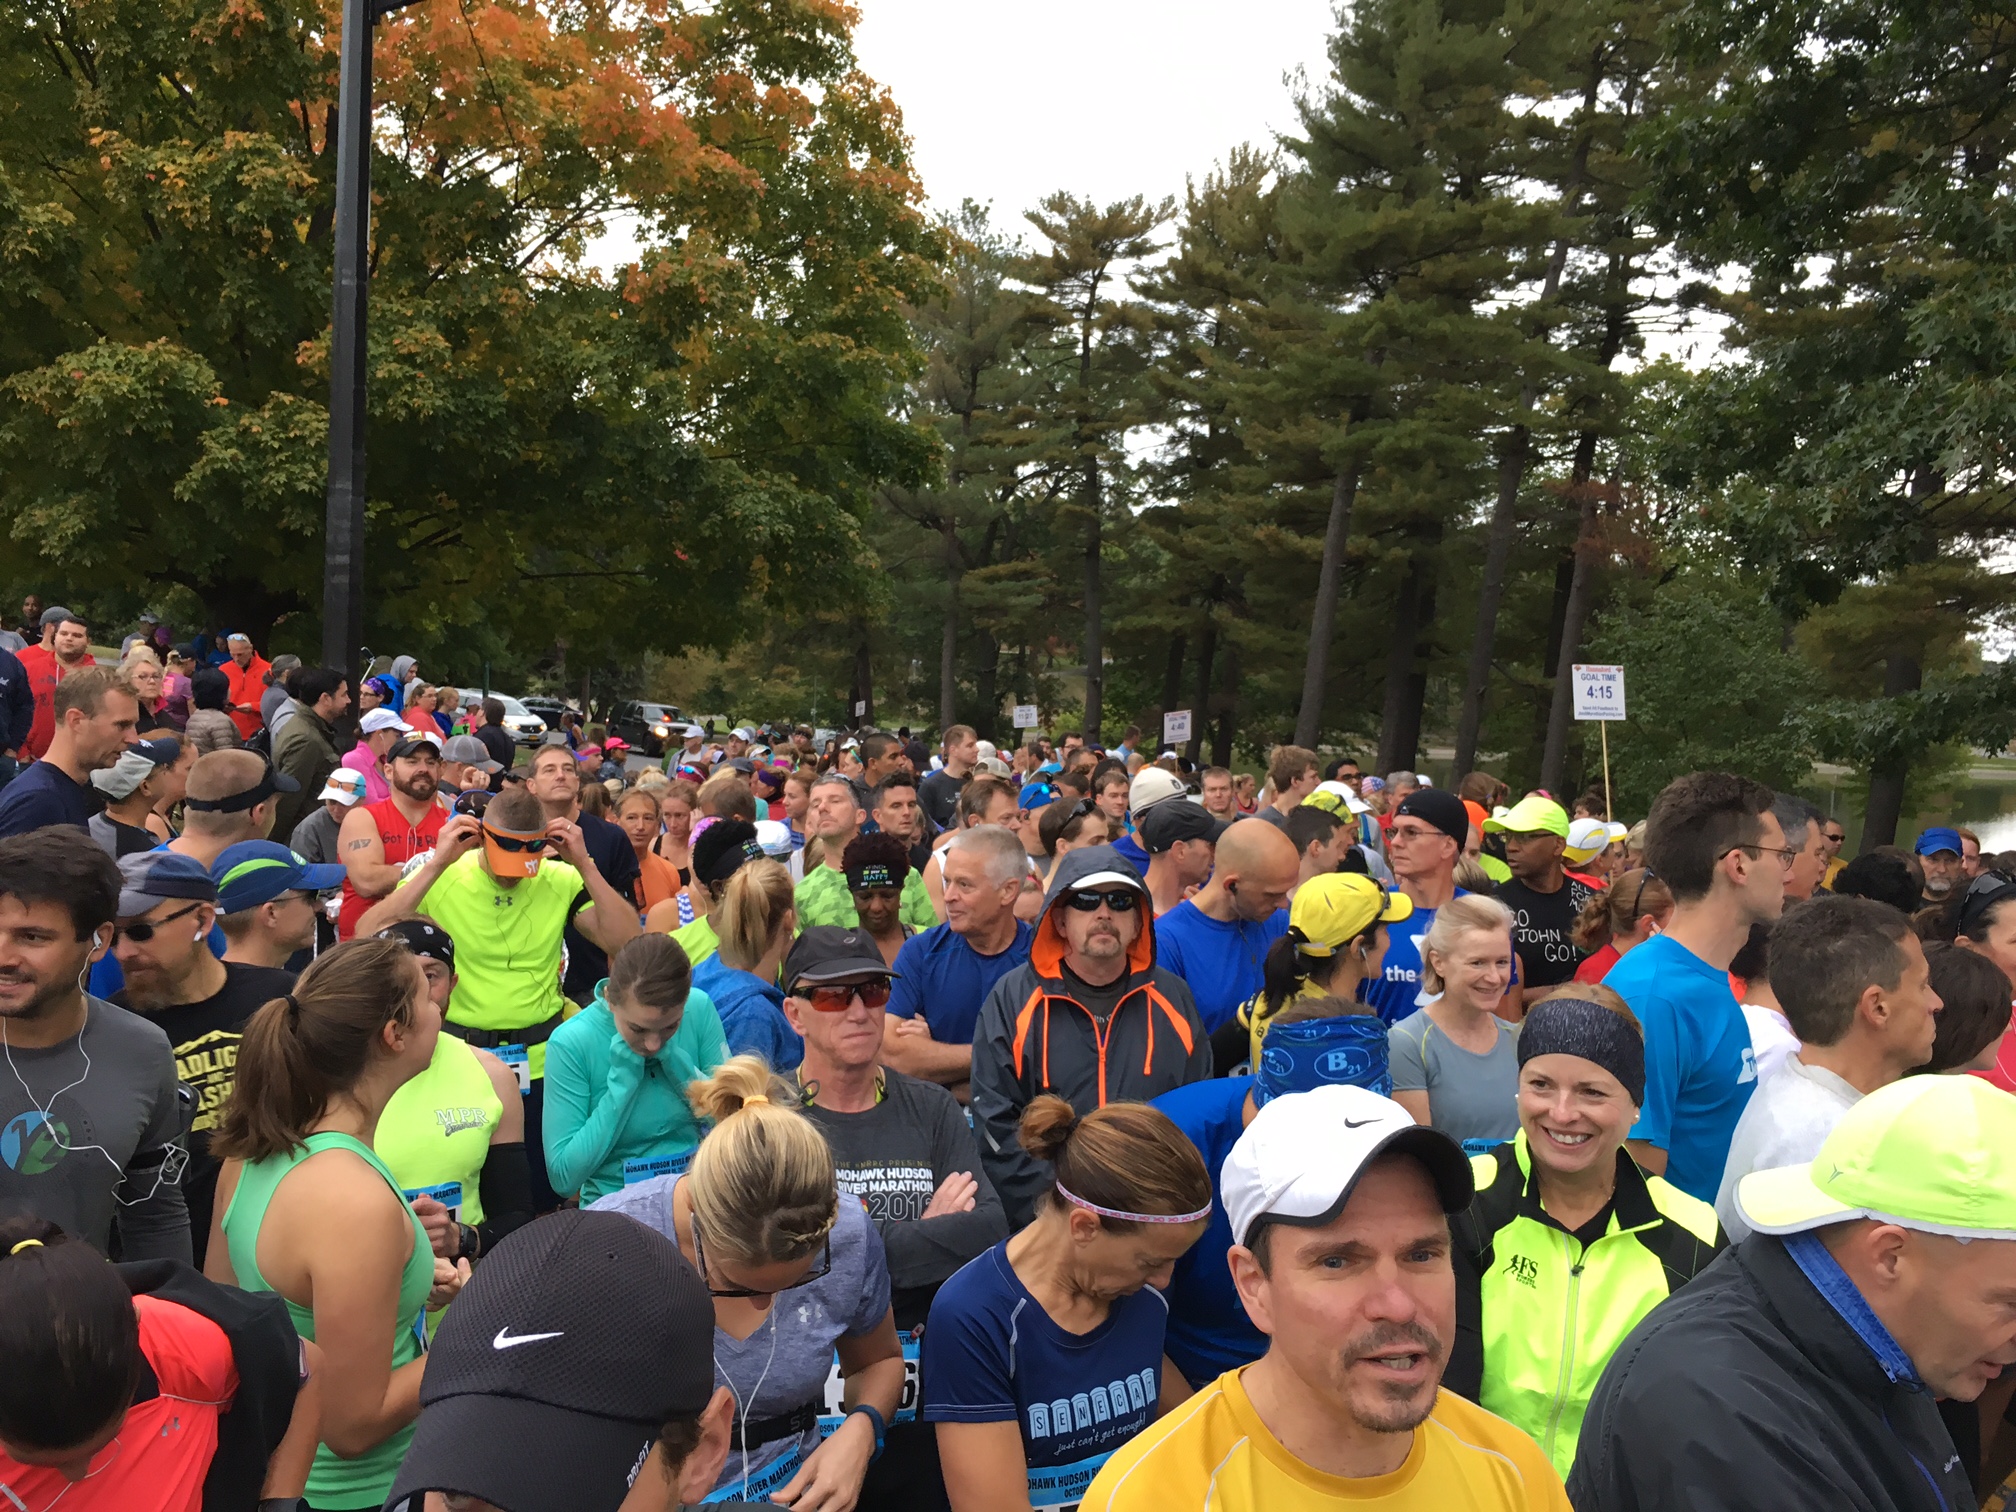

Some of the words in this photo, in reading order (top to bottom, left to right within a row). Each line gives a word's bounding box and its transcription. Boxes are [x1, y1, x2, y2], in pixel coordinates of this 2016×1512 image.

[1581, 673, 1600, 681] GOAL
[1587, 685, 1612, 699] 4:15
[382, 831, 402, 844] Got
[1571, 881, 1591, 895] ALL
[1518, 929, 1561, 943] JOHN
[1544, 943, 1577, 962] GO!
[1385, 965, 1416, 982] the
[434, 1107, 489, 1126] MPR
[625, 1164, 649, 1174] MOHAWK
[650, 1160, 671, 1171] HUDSON
[671, 1157, 685, 1167] RIVER
[836, 1168, 886, 1182] MOHAWK
[887, 1167, 933, 1180] HUDSON
[837, 1180, 868, 1195] RIVER
[869, 1180, 934, 1193] MARATHON
[1053, 1439, 1076, 1456] just
[1078, 1428, 1100, 1447] can't
[1100, 1427, 1116, 1444] get
[1117, 1410, 1147, 1434] enough!
[626, 1440, 649, 1488] DRI-FIT
[745, 1478, 769, 1499] RIVER
[769, 1451, 804, 1486] MARATHON
[1058, 1472, 1090, 1487] HUDSON
